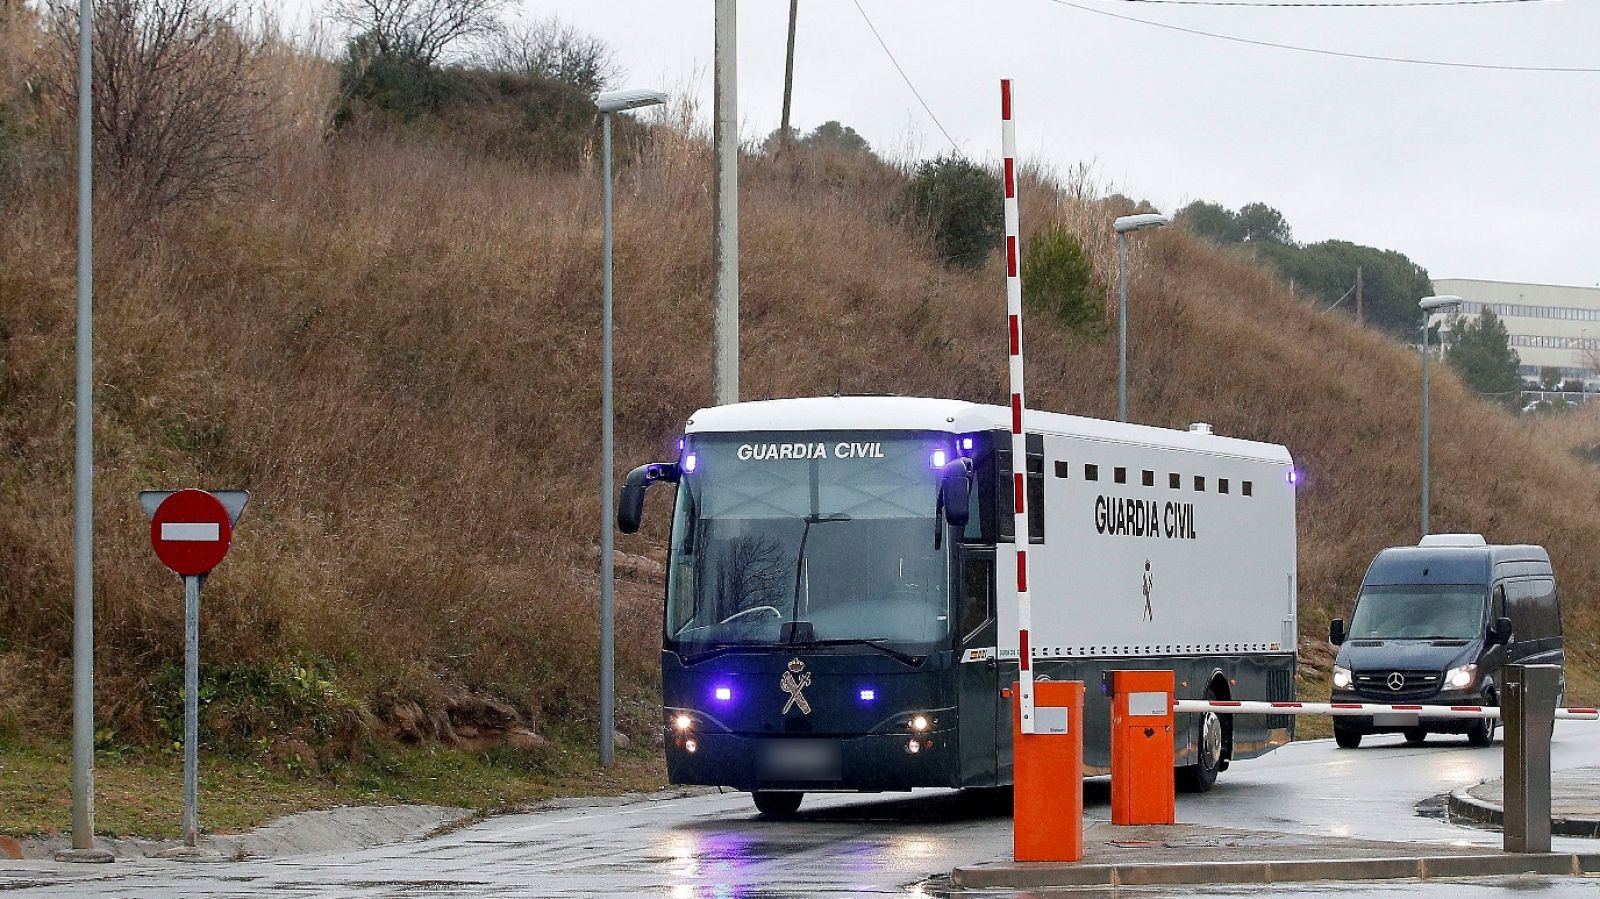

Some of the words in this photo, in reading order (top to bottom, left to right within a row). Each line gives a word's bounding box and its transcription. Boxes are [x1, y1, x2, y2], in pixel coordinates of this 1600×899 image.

[737, 443, 827, 460] GUARDIA
[834, 442, 884, 459] CIVIL
[1095, 494, 1159, 538] GUARDIA
[1164, 500, 1196, 539] CIVIL
